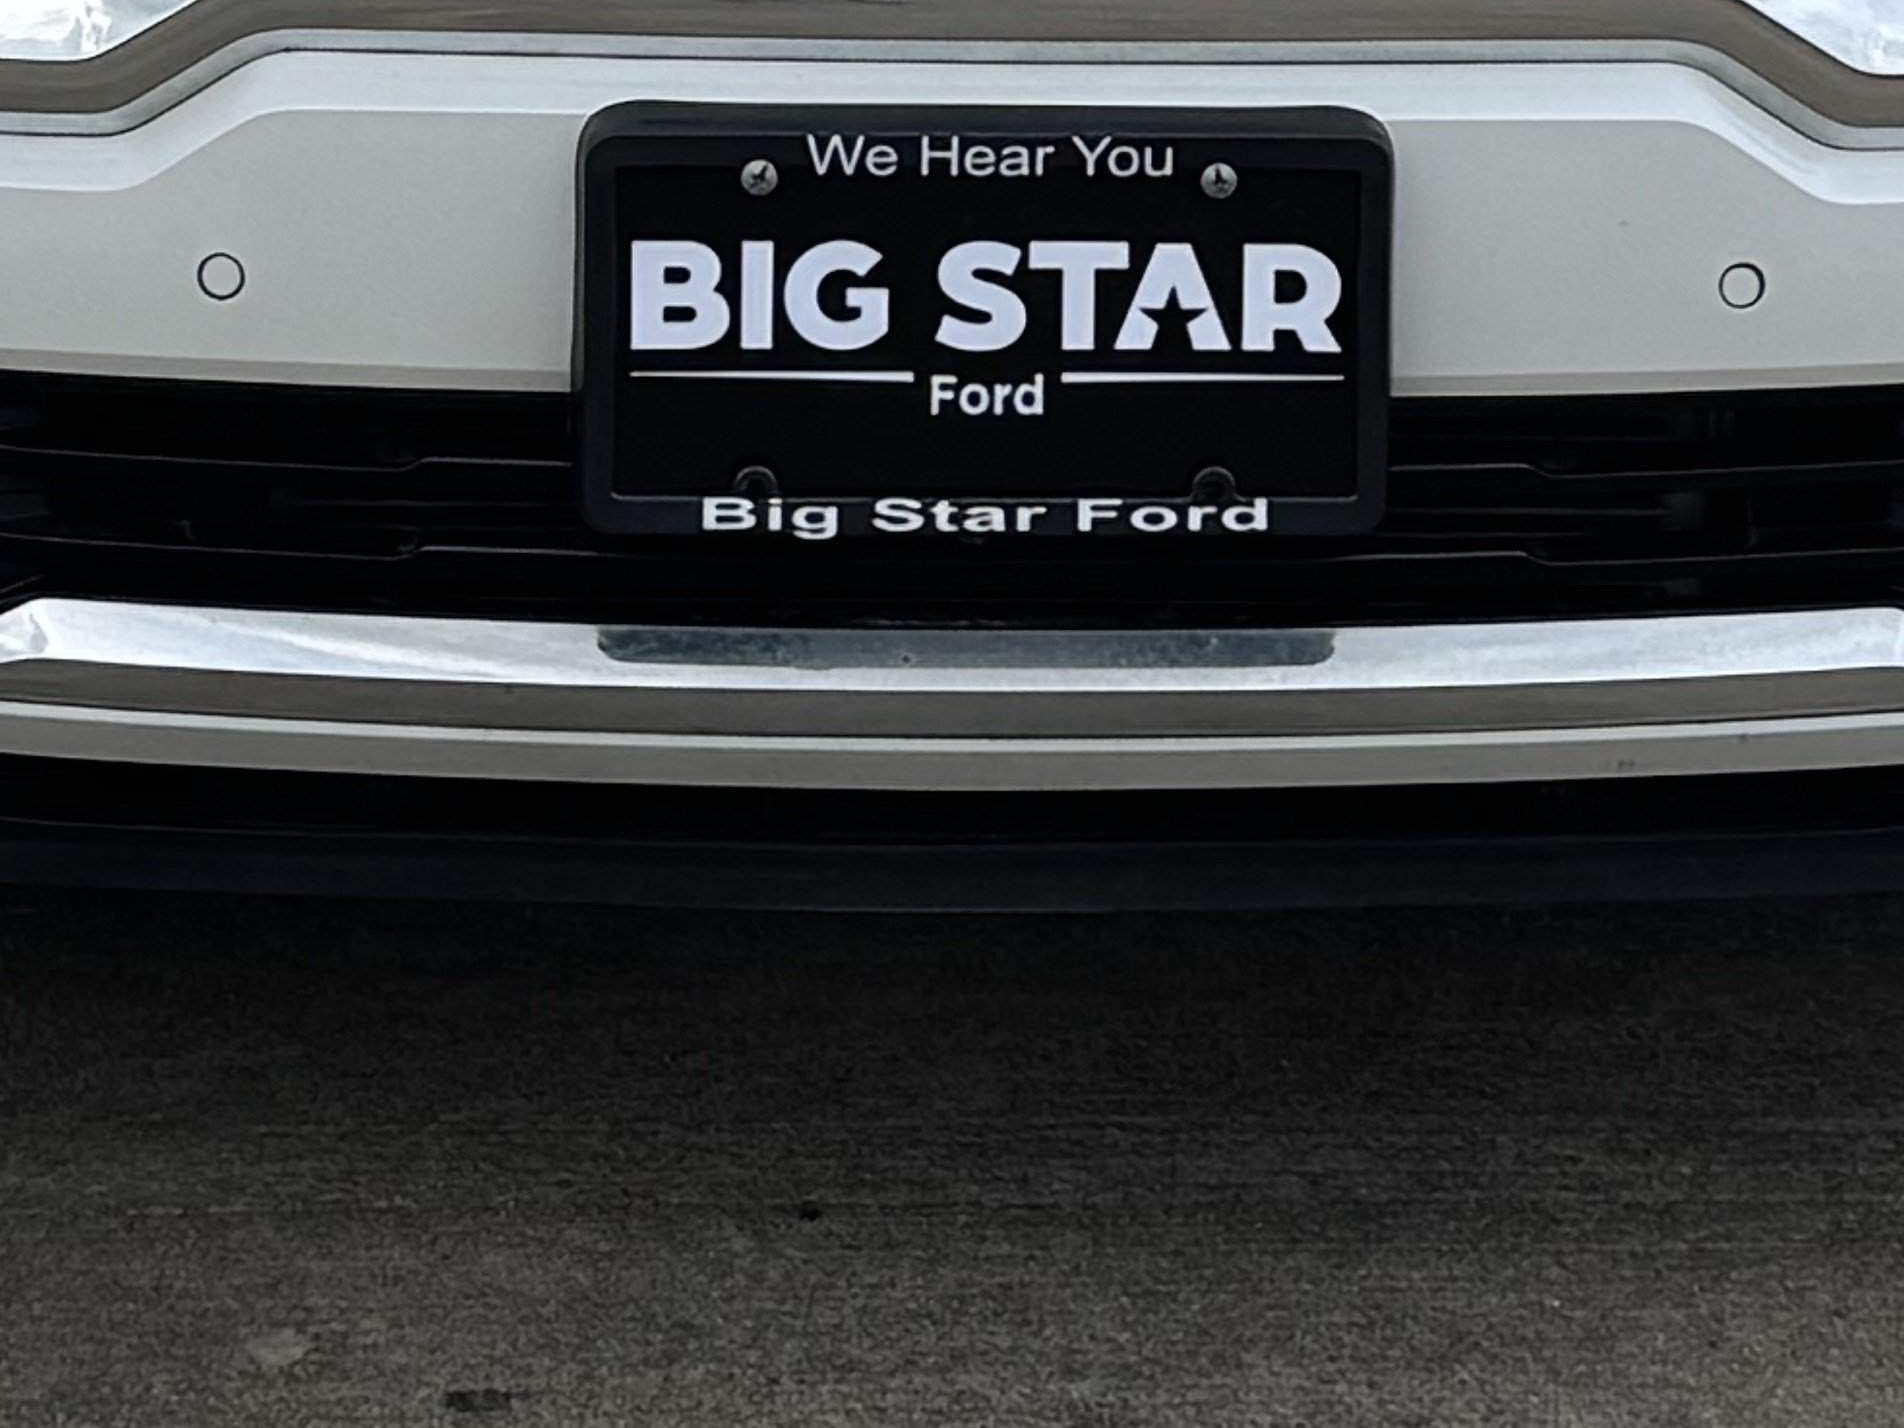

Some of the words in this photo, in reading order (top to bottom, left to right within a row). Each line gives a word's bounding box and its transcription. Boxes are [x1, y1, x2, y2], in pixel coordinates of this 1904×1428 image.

[806, 133, 898, 177] We
[919, 134, 1055, 177] Hear
[1071, 134, 1174, 178] You
[629, 239, 890, 352] BIG
[934, 239, 1343, 354] STAR
[929, 373, 1045, 417] Ford
[701, 496, 839, 541] Big
[871, 497, 1047, 533] Star
[1076, 497, 1269, 533] Ford
